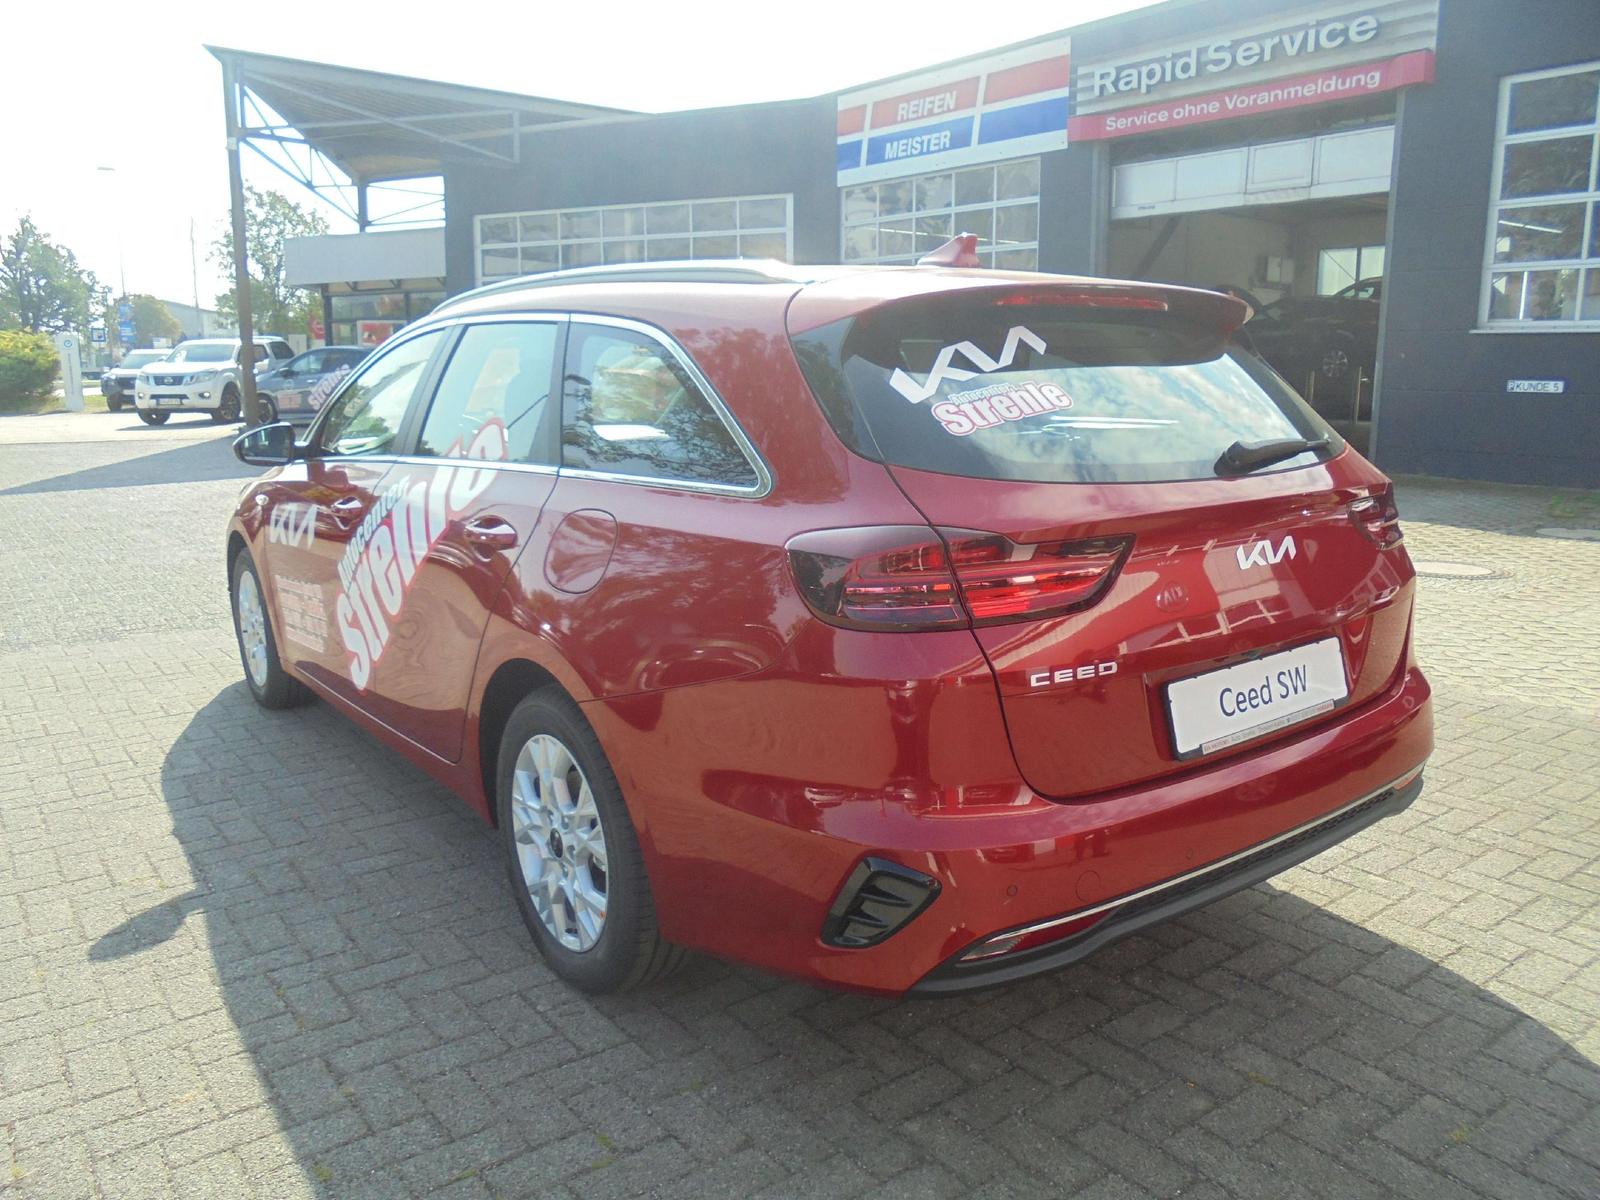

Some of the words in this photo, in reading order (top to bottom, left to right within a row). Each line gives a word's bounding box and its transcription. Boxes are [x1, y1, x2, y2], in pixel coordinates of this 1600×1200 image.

[1092, 49, 1198, 101] Rapid
[1205, 14, 1380, 77] Service
[897, 90, 957, 122] REIFEN
[1105, 108, 1170, 132] Service
[1173, 100, 1221, 122] ohne
[1224, 69, 1382, 111] Voranmeldung
[884, 130, 951, 161] MEISTER
[932, 381, 1072, 436] Strehle
[336, 418, 507, 694] Strehle
[1236, 536, 1297, 571] KIA
[1030, 661, 1119, 688] CEED
[1219, 675, 1274, 718] Ceed
[1278, 664, 1310, 700] SW
